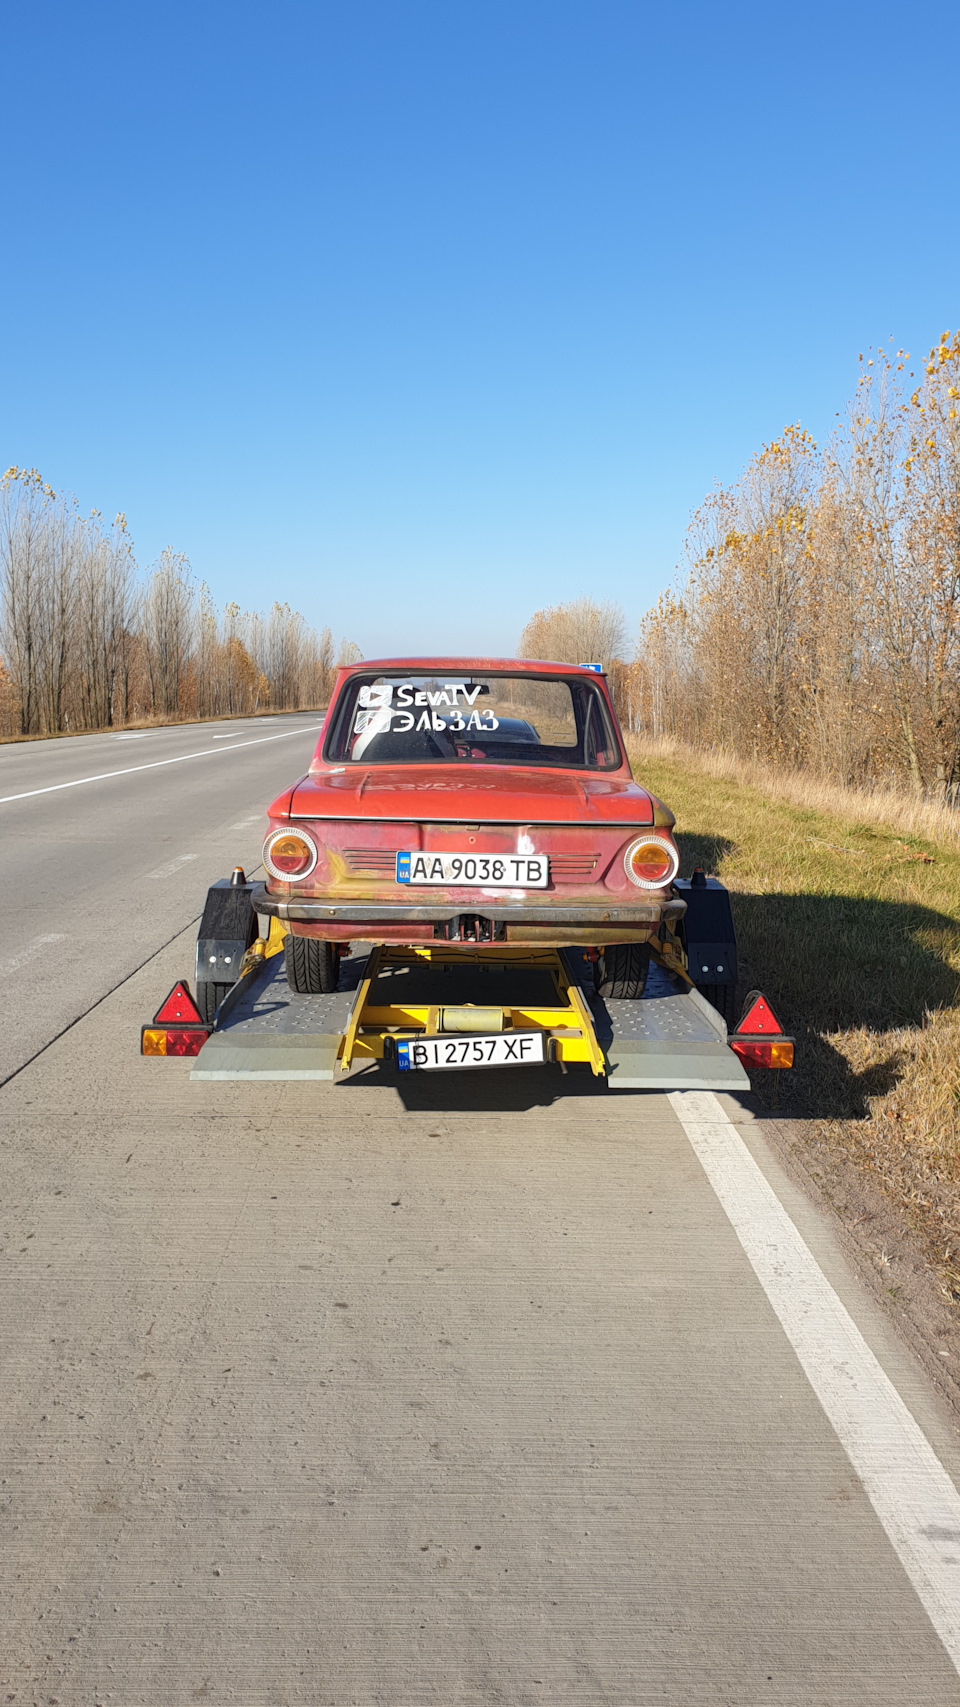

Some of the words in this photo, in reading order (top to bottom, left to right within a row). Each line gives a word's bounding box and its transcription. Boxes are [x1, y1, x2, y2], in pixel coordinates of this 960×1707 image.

[399, 871, 410, 879] UA
[412, 857, 444, 879] AA
[451, 858, 504, 880] 9038
[510, 860, 542, 882] TB
[413, 1044, 439, 1065] BI
[445, 1040, 497, 1063] 2757
[503, 1038, 534, 1060] XF
